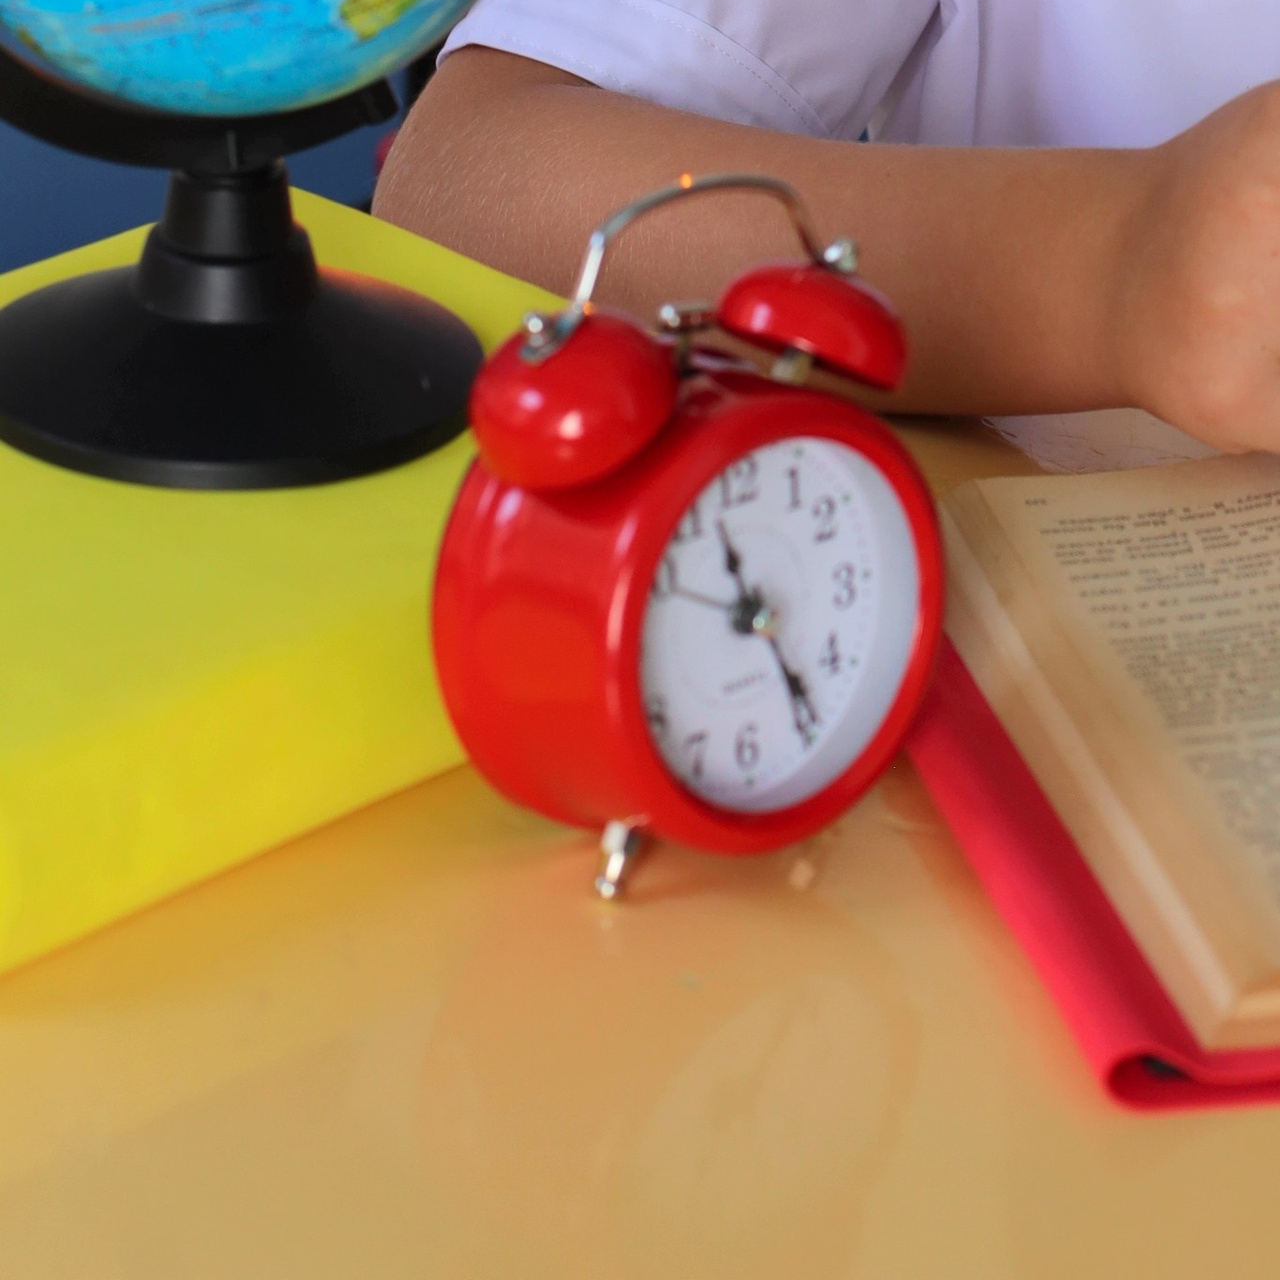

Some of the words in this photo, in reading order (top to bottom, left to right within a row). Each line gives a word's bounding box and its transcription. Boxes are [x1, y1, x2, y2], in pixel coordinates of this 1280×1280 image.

[786, 465, 803, 509] 1
[812, 495, 837, 544] 2
[833, 563, 857, 611] 3
[818, 631, 843, 675] 4
[684, 731, 709, 779] 7
[735, 723, 761, 771] 6
